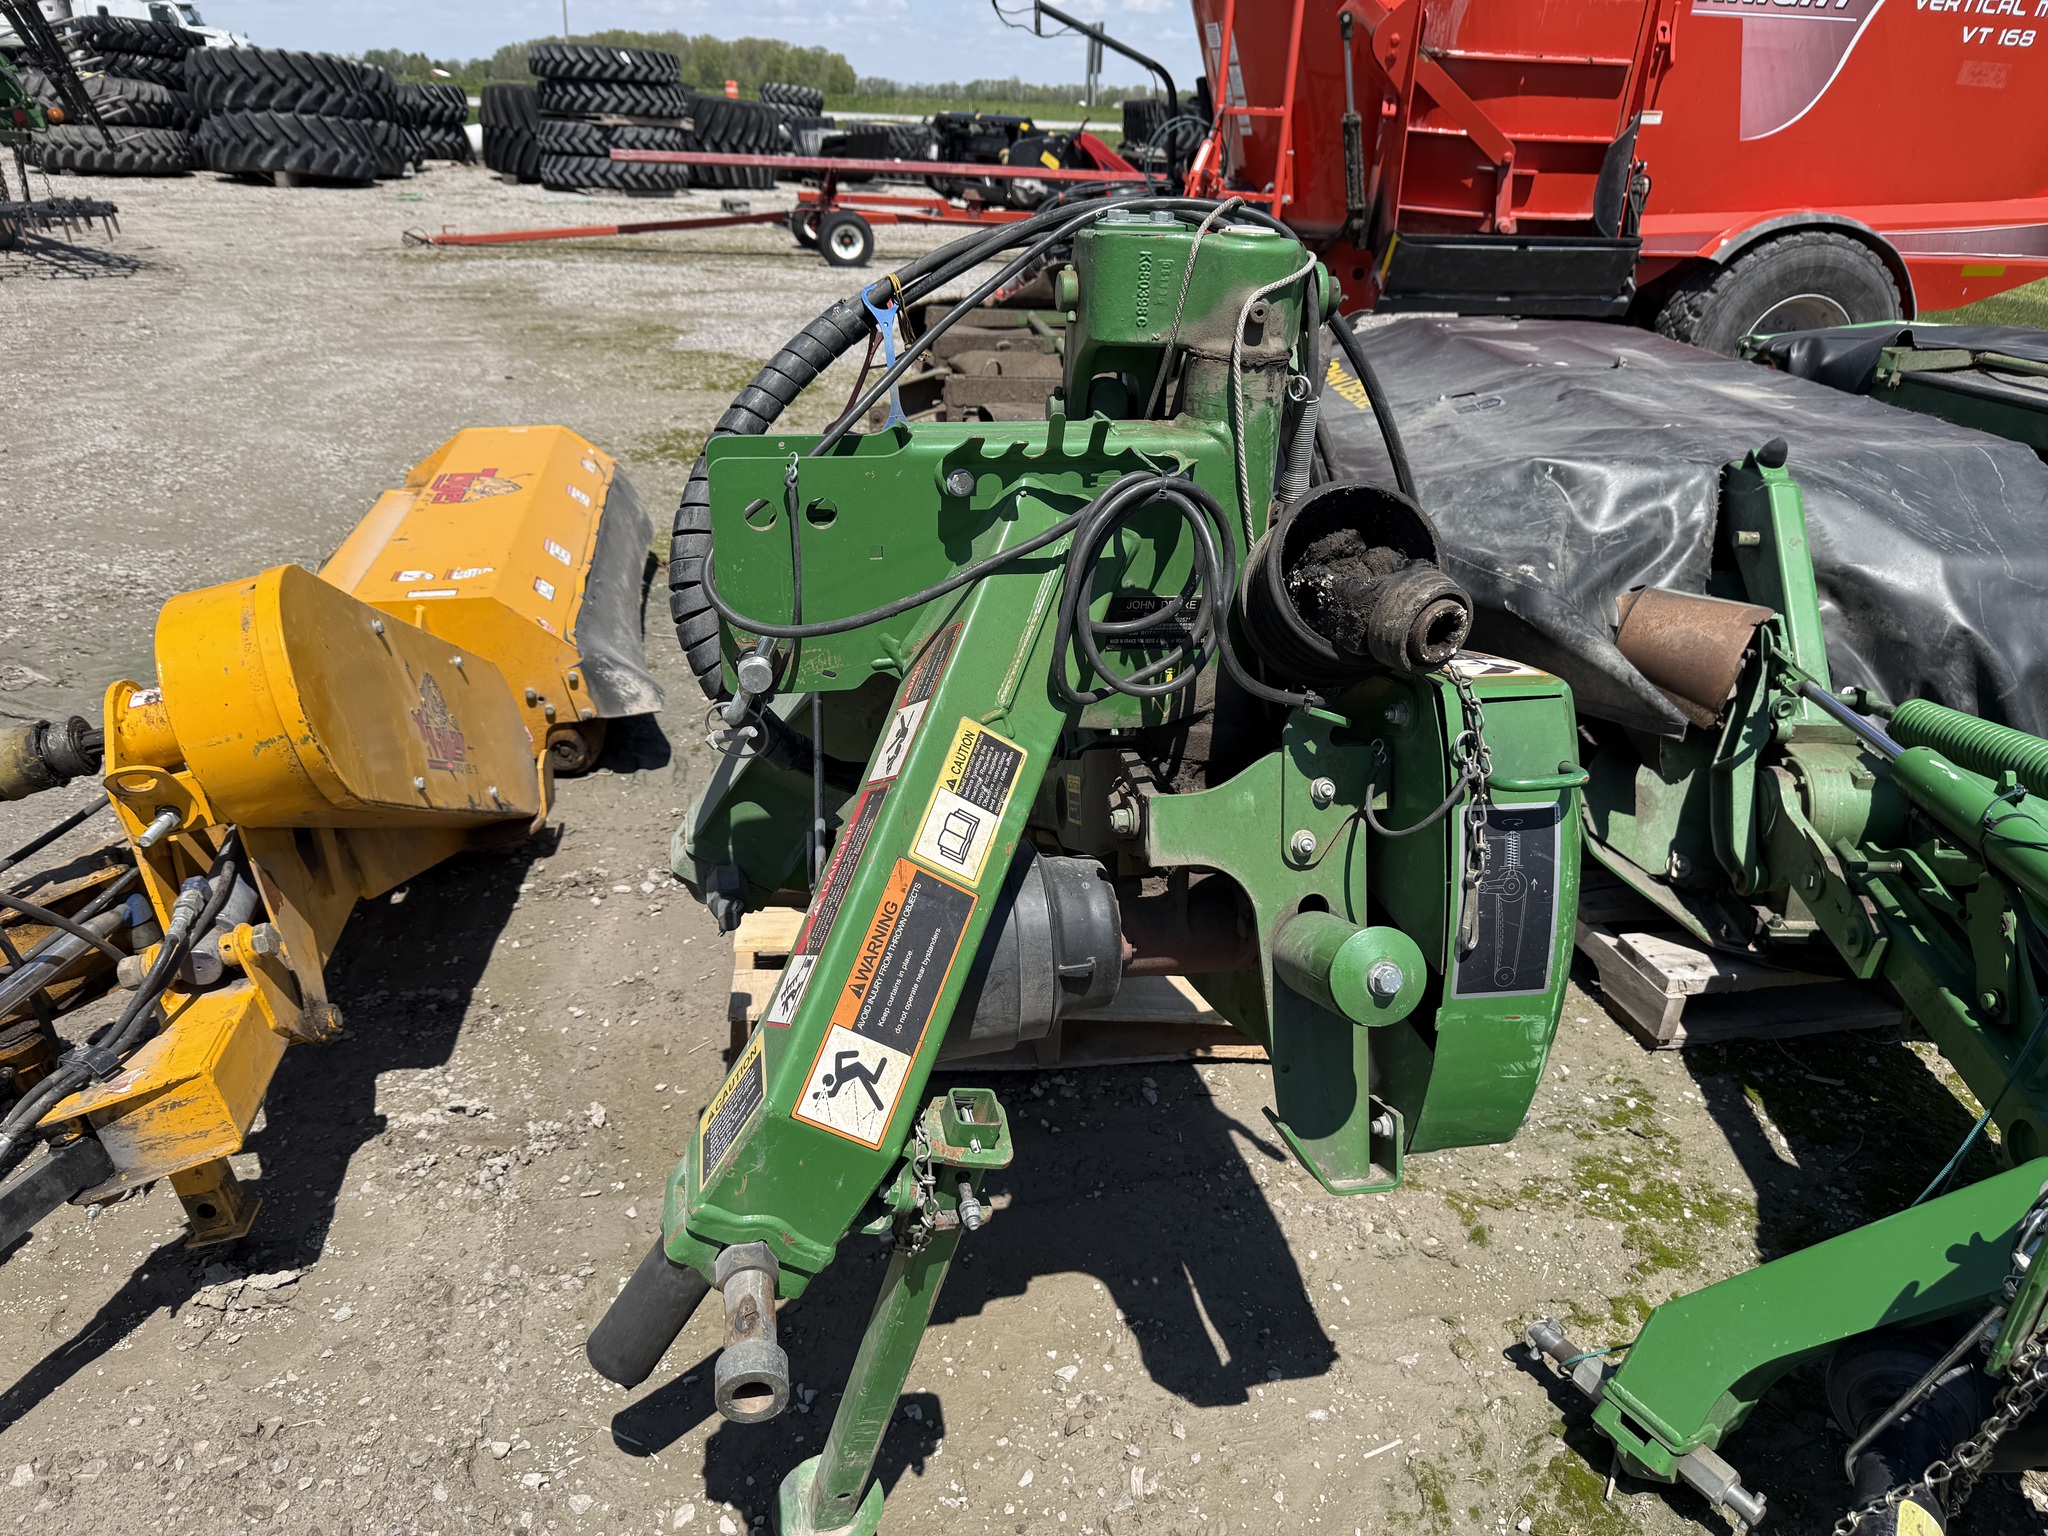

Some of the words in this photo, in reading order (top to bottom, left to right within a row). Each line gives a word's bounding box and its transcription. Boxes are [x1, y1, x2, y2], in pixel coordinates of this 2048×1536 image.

[1963, 26, 1994, 44] VT
[1997, 28, 2037, 47] 168
[1126, 600, 1155, 610] JOHN
[951, 730, 975, 774] CAUTION
[964, 754, 975, 778] operator
[974, 733, 984, 754] manual
[980, 751, 992, 774] Request
[993, 752, 1006, 782] instructions
[1000, 767, 1008, 781] rules
[1006, 752, 1014, 766] when
[963, 779, 974, 797] before
[822, 823, 855, 891] DANGER
[856, 902, 897, 980] WARNING
[858, 1005, 871, 1030] AVOID
[867, 976, 882, 1004] INJURY
[879, 952, 893, 976] FROM
[888, 917, 907, 951] THROWN
[903, 883, 921, 917] OBJECTS
[878, 1008, 890, 1026] Keep
[887, 979, 901, 1006] curtains
[902, 950, 913, 970] place.
[895, 1024, 902, 1034] do
[900, 1011, 908, 1023] not
[905, 984, 918, 1010] operate
[916, 966, 925, 982] near
[922, 928, 941, 965] bystanders.
[716, 1046, 756, 1111] CAUTION
